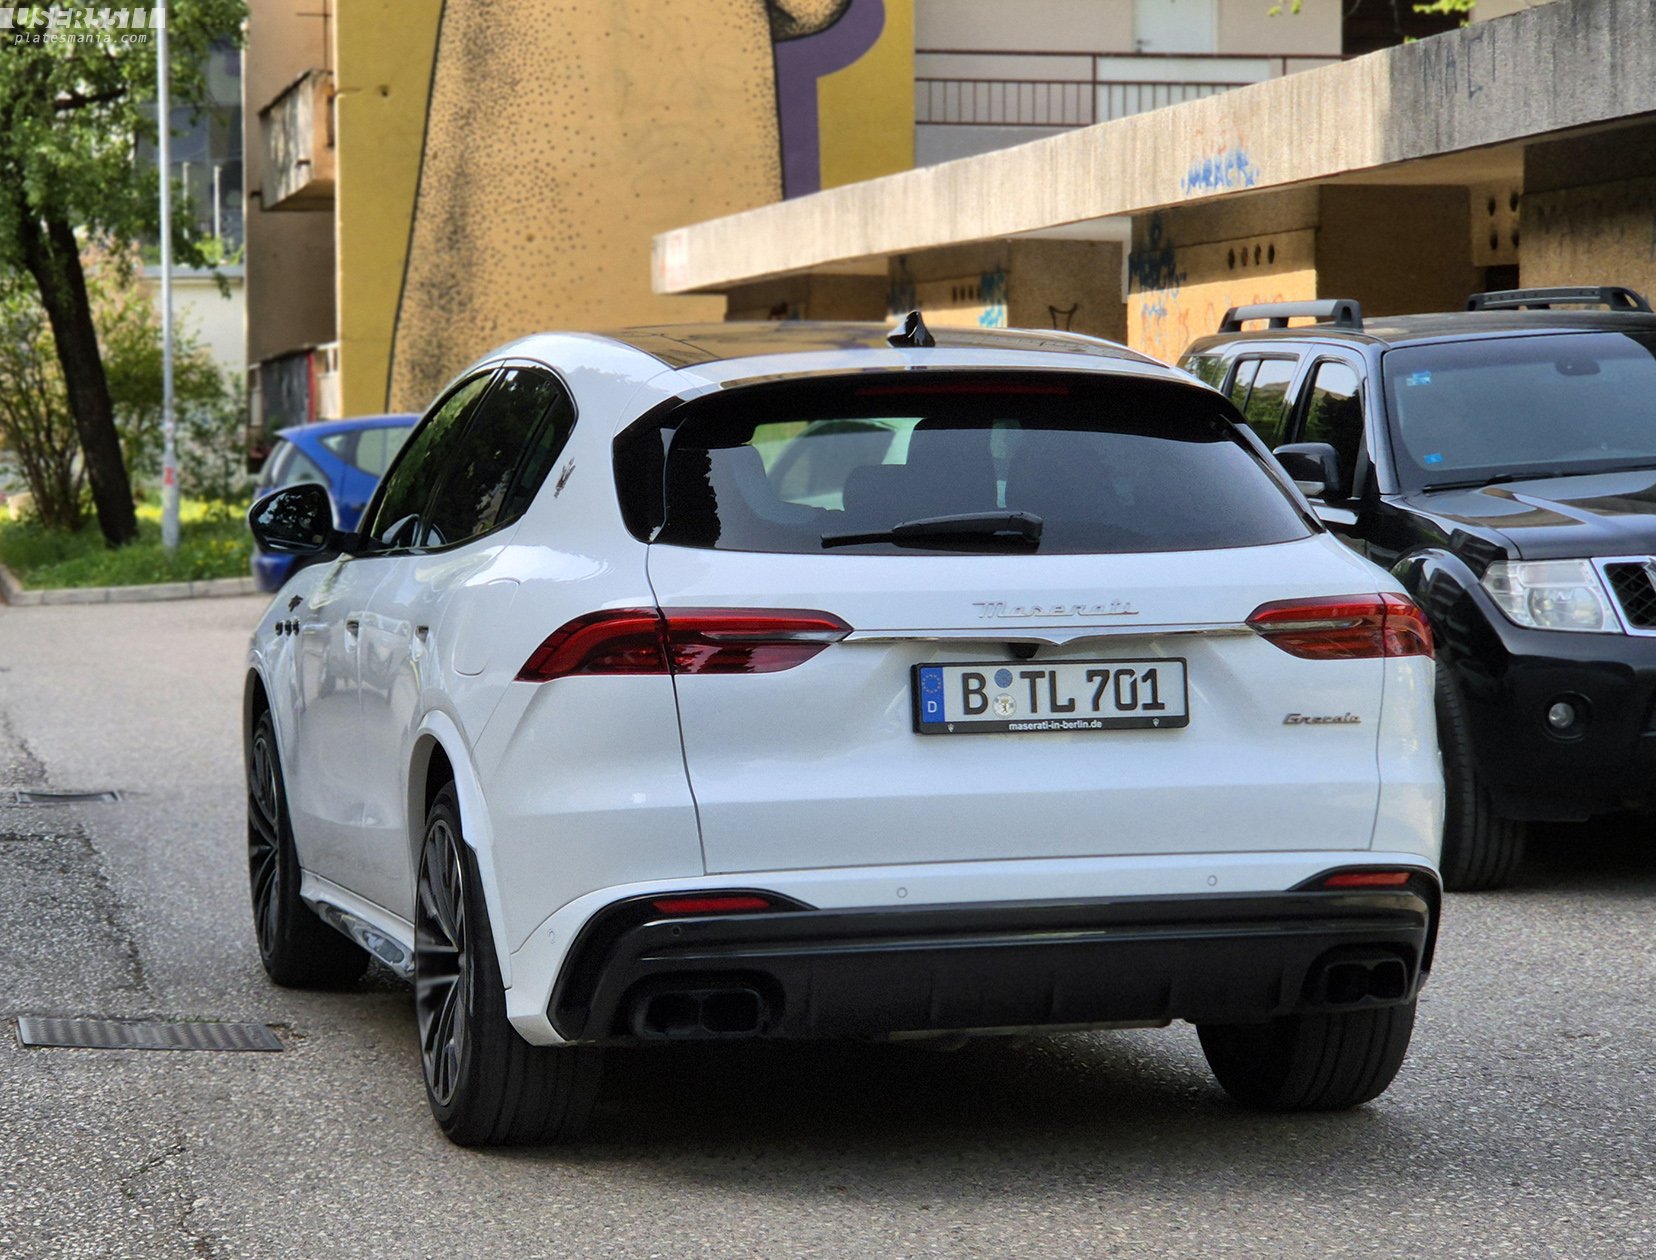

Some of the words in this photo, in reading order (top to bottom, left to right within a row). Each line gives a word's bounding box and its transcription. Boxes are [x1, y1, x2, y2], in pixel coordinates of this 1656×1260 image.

[962, 672, 989, 715] B
[1019, 670, 1076, 714] TL
[1086, 668, 1166, 712] 701
[927, 701, 938, 713] D
[1008, 720, 1103, 731] maserati-in-berlin.de
